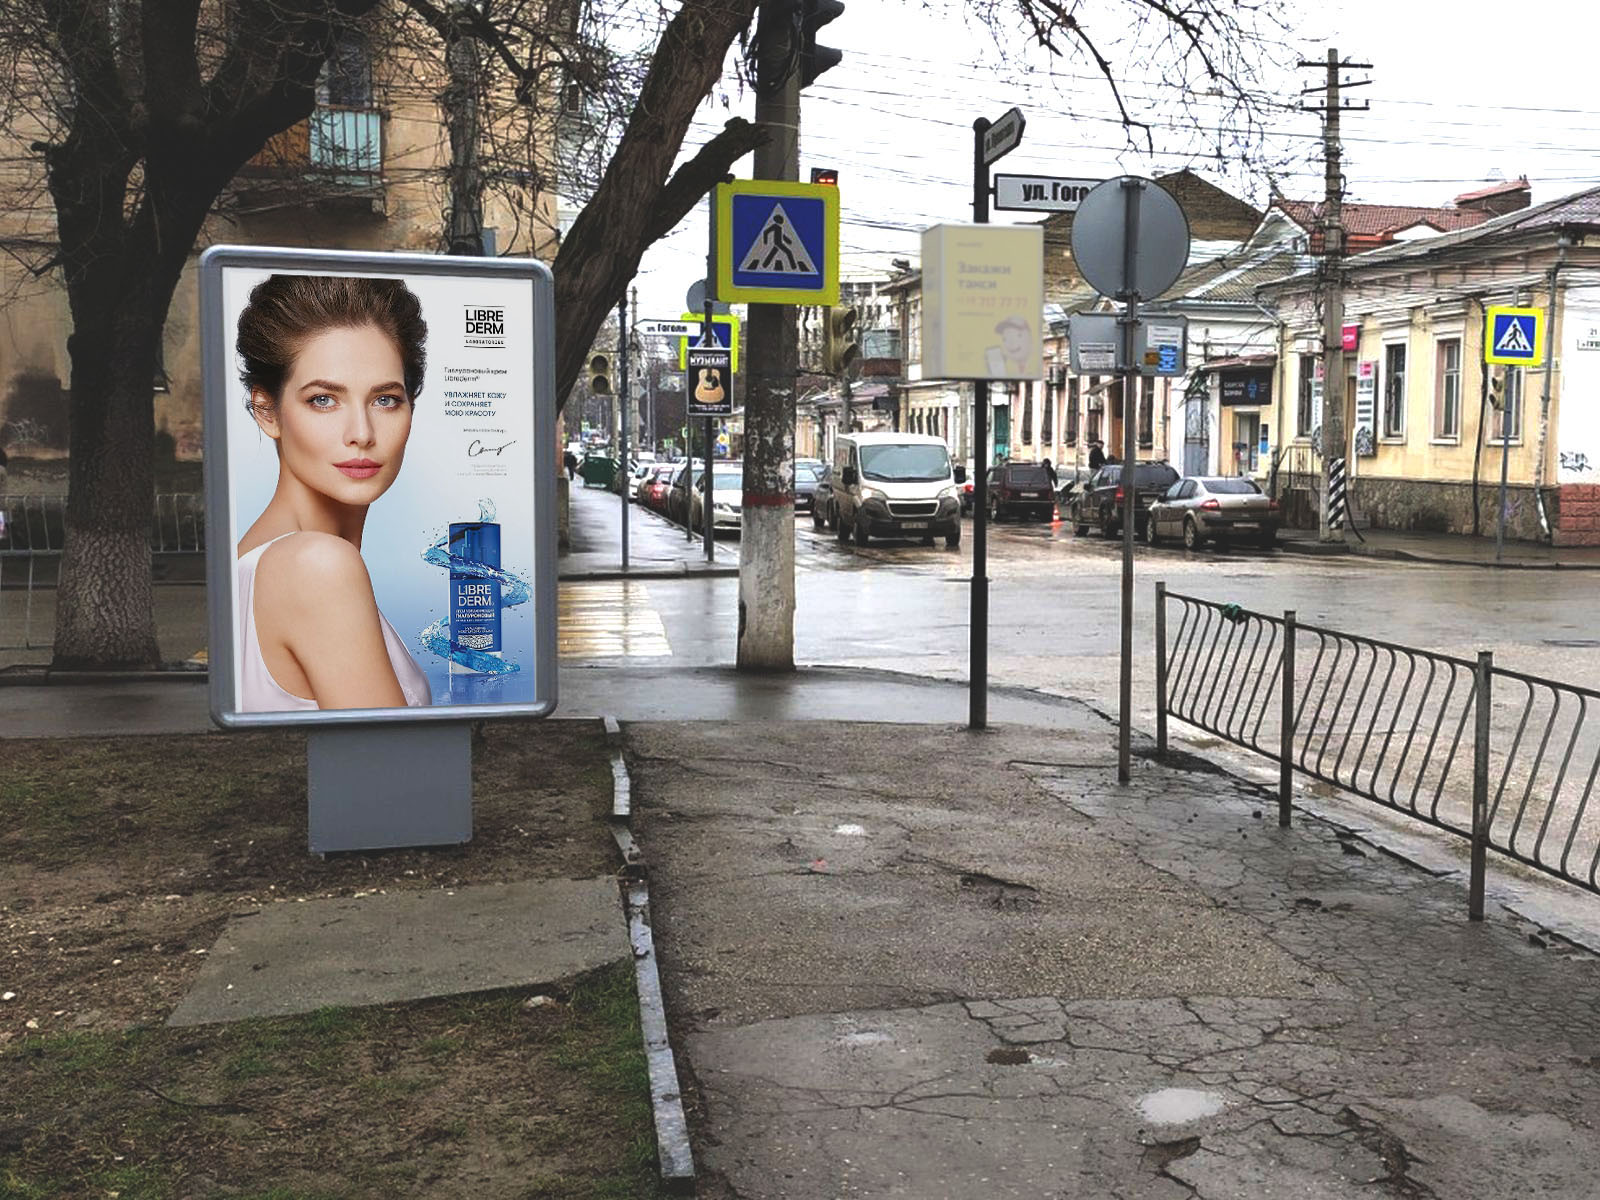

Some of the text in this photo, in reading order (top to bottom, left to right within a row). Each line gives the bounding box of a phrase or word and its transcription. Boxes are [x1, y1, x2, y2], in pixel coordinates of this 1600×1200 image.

[1022, 184, 1048, 202] ул.
[465, 309, 504, 322] LIBRE
[465, 321, 504, 335] DERM
[444, 391, 507, 400] УВЛАЖНЯЕТ КОЖУ
[451, 400, 492, 408] СОХРАНЯЕТ
[445, 409, 463, 417] МОЮ
[458, 584, 492, 596] LIBRE
[458, 596, 491, 607] DERM
